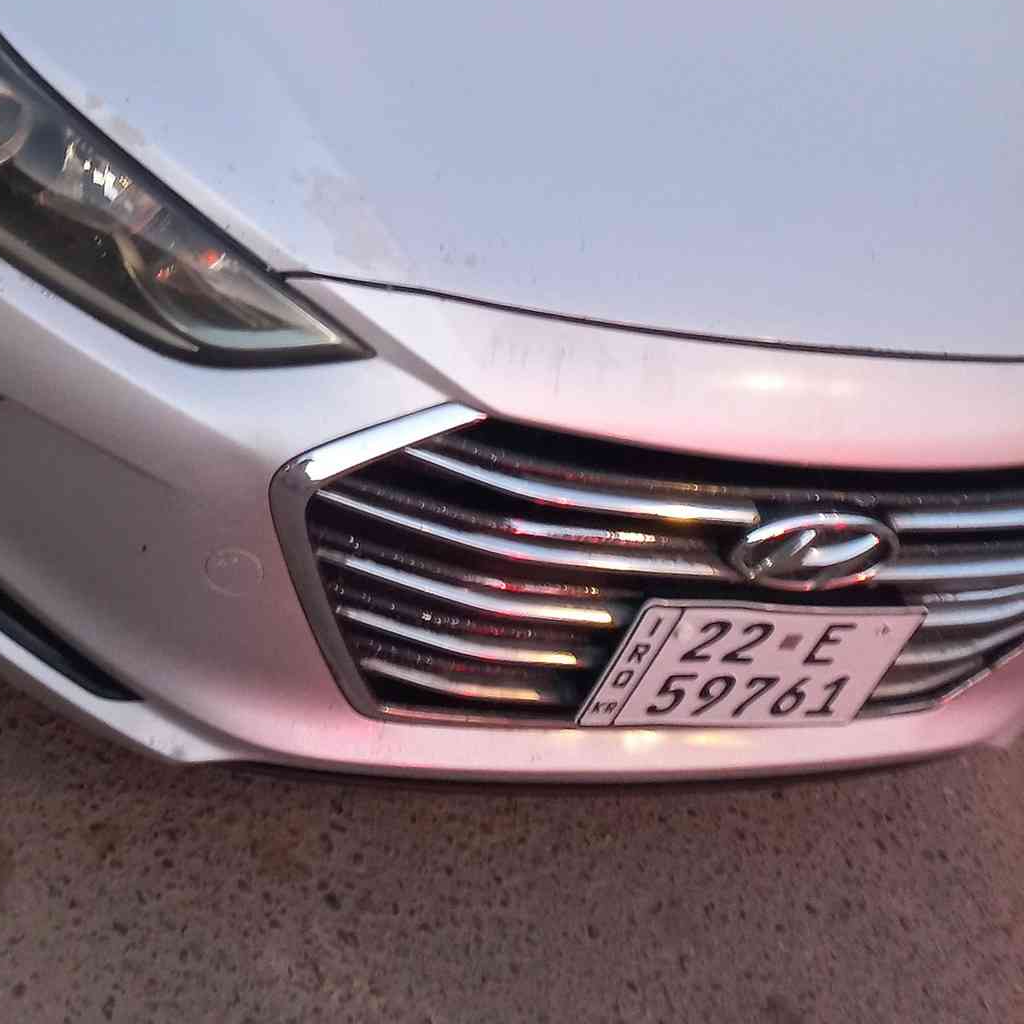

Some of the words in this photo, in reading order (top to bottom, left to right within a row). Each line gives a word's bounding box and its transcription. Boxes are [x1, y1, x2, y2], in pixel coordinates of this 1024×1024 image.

[680, 620, 775, 664] 22
[803, 622, 857, 666] E
[646, 674, 850, 717] 59761
